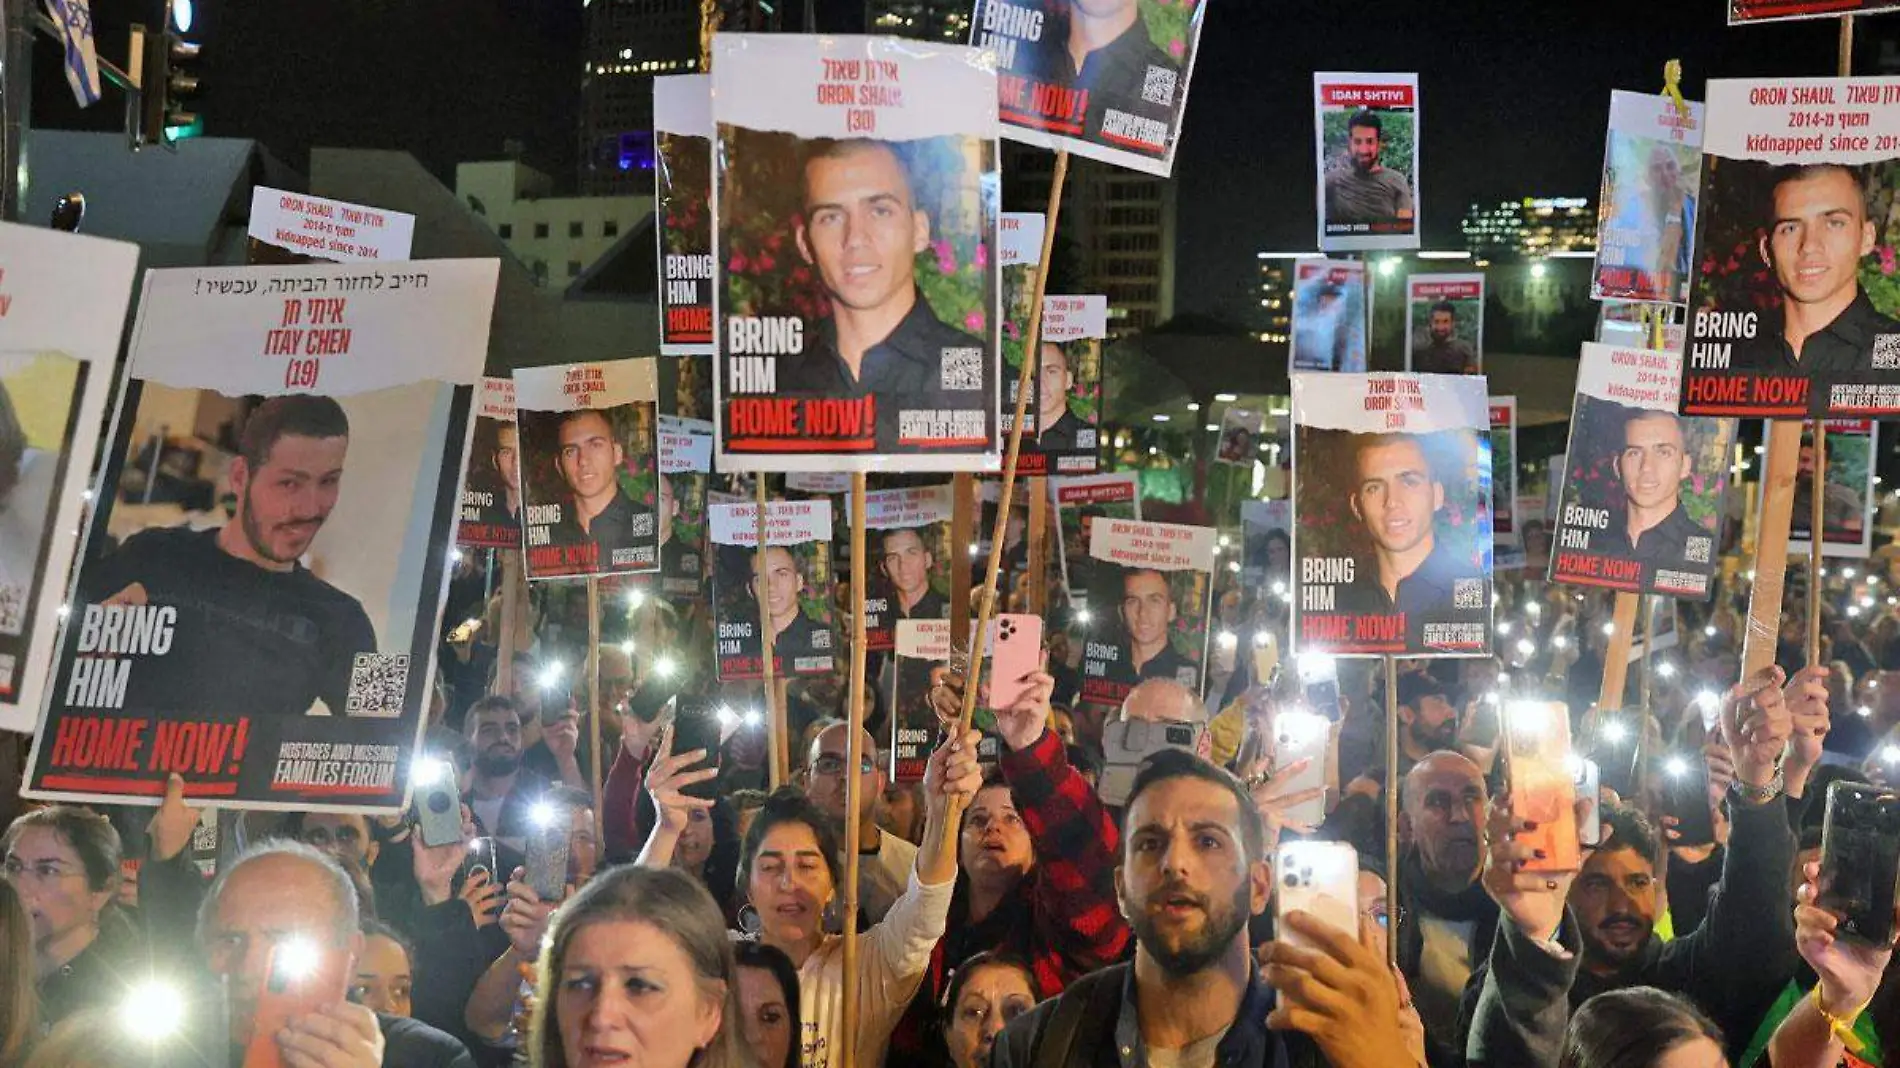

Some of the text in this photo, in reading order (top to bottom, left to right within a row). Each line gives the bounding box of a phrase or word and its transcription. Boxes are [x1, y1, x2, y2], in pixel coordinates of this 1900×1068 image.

[983, 0, 1044, 42] BRING
[817, 84, 855, 104] ORON
[1031, 80, 1089, 123] NOW!
[1332, 89, 1404, 100] IDAN SHTIVI
[1749, 87, 1787, 105] ORON
[1792, 86, 1836, 105] SHAUL
[1846, 84, 1880, 103] שאול
[847, 107, 875, 132] (30)
[1839, 112, 1869, 129] חטוף
[1746, 133, 1900, 155] kidnapped since 201
[280, 196, 304, 213] ORON
[276, 228, 379, 258] kidnapped since 2014
[334, 270, 384, 291] לחזור
[388, 273, 429, 289] חייב
[667, 281, 697, 305] HIM
[282, 297, 346, 327] איתי חן
[728, 316, 804, 355] BRING
[1694, 311, 1758, 339] BRING
[264, 328, 352, 355] ITAY CHEN
[1691, 342, 1732, 369] HIM
[285, 357, 320, 388] (19)
[729, 357, 776, 394] HIM
[1608, 382, 1659, 401] kidnapped
[1688, 376, 1809, 404] HOME NOW!
[729, 394, 876, 436] HOME NOW!
[1364, 396, 1392, 410] ORON
[527, 503, 562, 525] BRING
[1564, 505, 1610, 529] BRING
[529, 525, 550, 546] HIM
[1560, 527, 1590, 550] HIM
[1302, 557, 1355, 584] BRING
[1556, 552, 1641, 580] HOME NOW!
[1302, 586, 1335, 611] HIM
[78, 604, 177, 656] BRING
[720, 623, 752, 638] BRING
[1302, 612, 1406, 641] HOME NOW!
[720, 640, 741, 655] HIM
[1086, 642, 1118, 660] BRING
[1085, 659, 1106, 676] HIM
[65, 657, 133, 709] HIM
[51, 716, 250, 775] HOME NOW!
[898, 729, 927, 743] BRING
[280, 743, 331, 760] HOSTAGES
[331, 743, 352, 760] AND
[897, 745, 916, 758] HIM
[274, 760, 395, 787] FAMILIES FORUM
